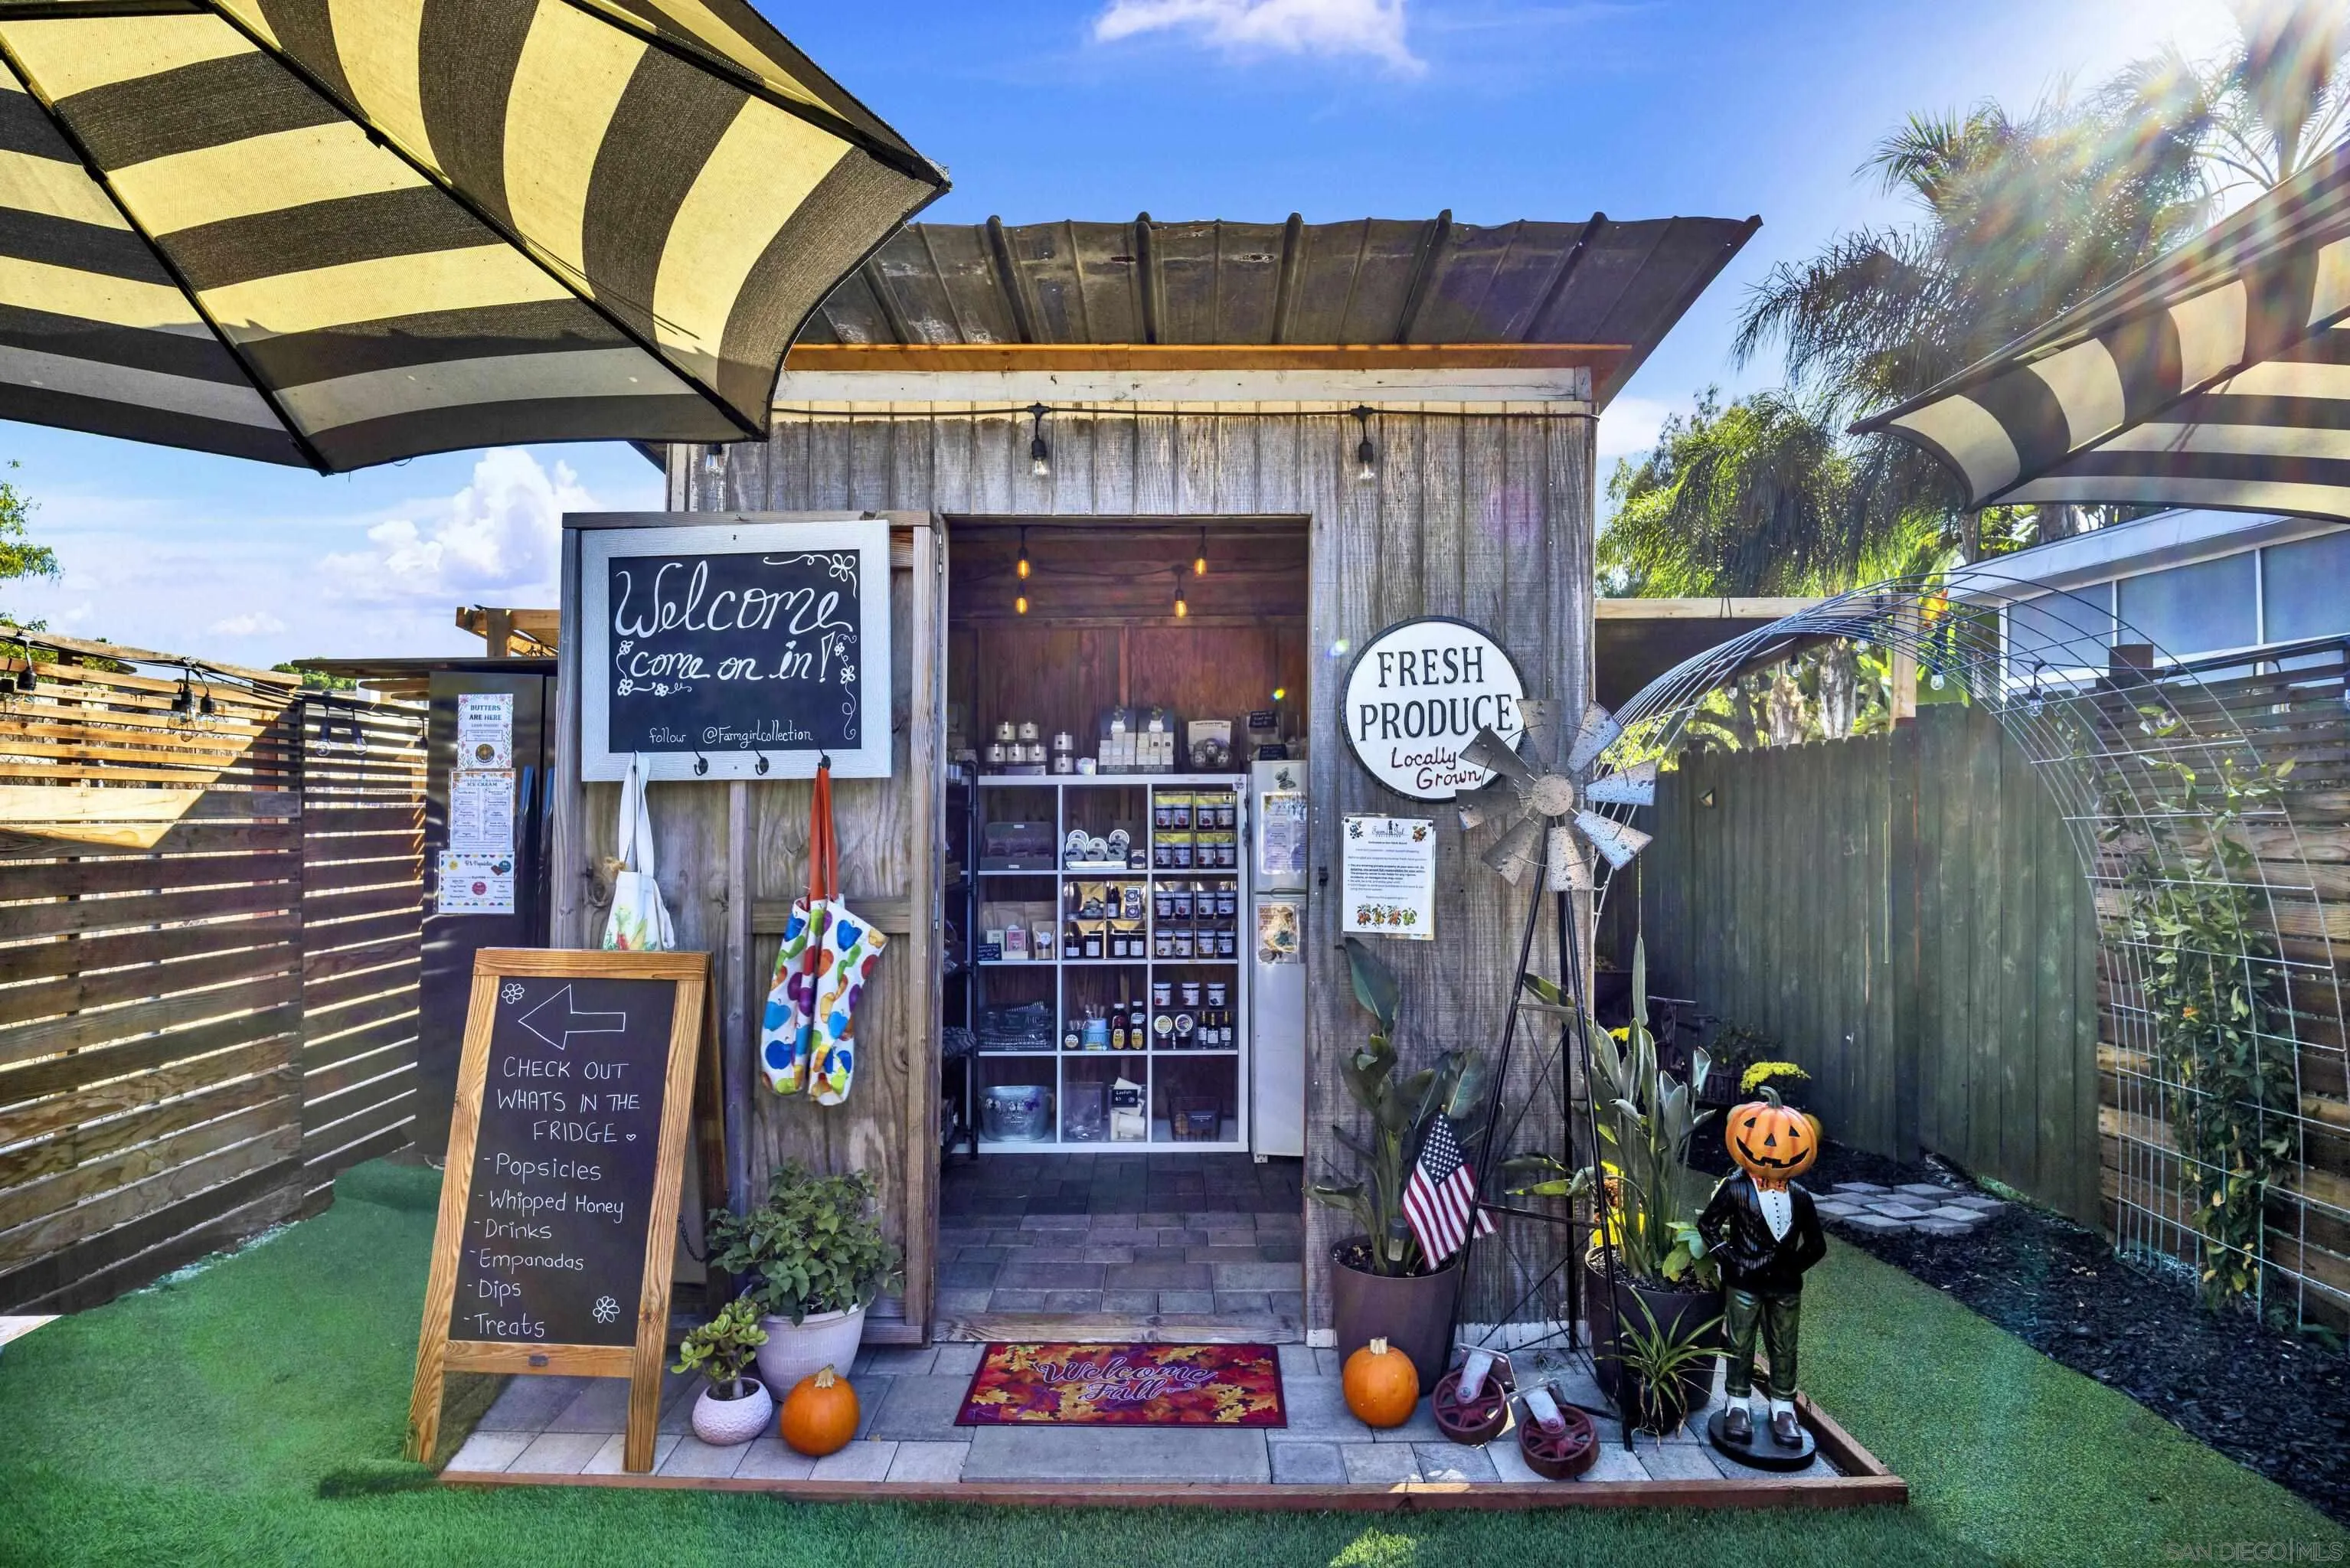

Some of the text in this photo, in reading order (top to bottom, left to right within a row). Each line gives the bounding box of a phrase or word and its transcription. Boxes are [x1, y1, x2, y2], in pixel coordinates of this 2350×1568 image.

[615, 560, 853, 638] Welcome
[629, 631, 836, 683] come on in!
[1377, 645, 1484, 688] FRESH
[1359, 694, 1513, 742] PRODUCE
[649, 727, 686, 743] follow
[1391, 746, 1456, 769] Locally
[1416, 767, 1482, 790] Grown
[502, 1056, 629, 1080] CHECK OUT
[497, 1089, 640, 1112] WHATS IN THE
[533, 1120, 618, 1144] FRIDGE
[575, 1200, 624, 1223] Honey
[1034, 1356, 1218, 1385] Welcome
[1077, 1378, 1179, 1402] Fall
